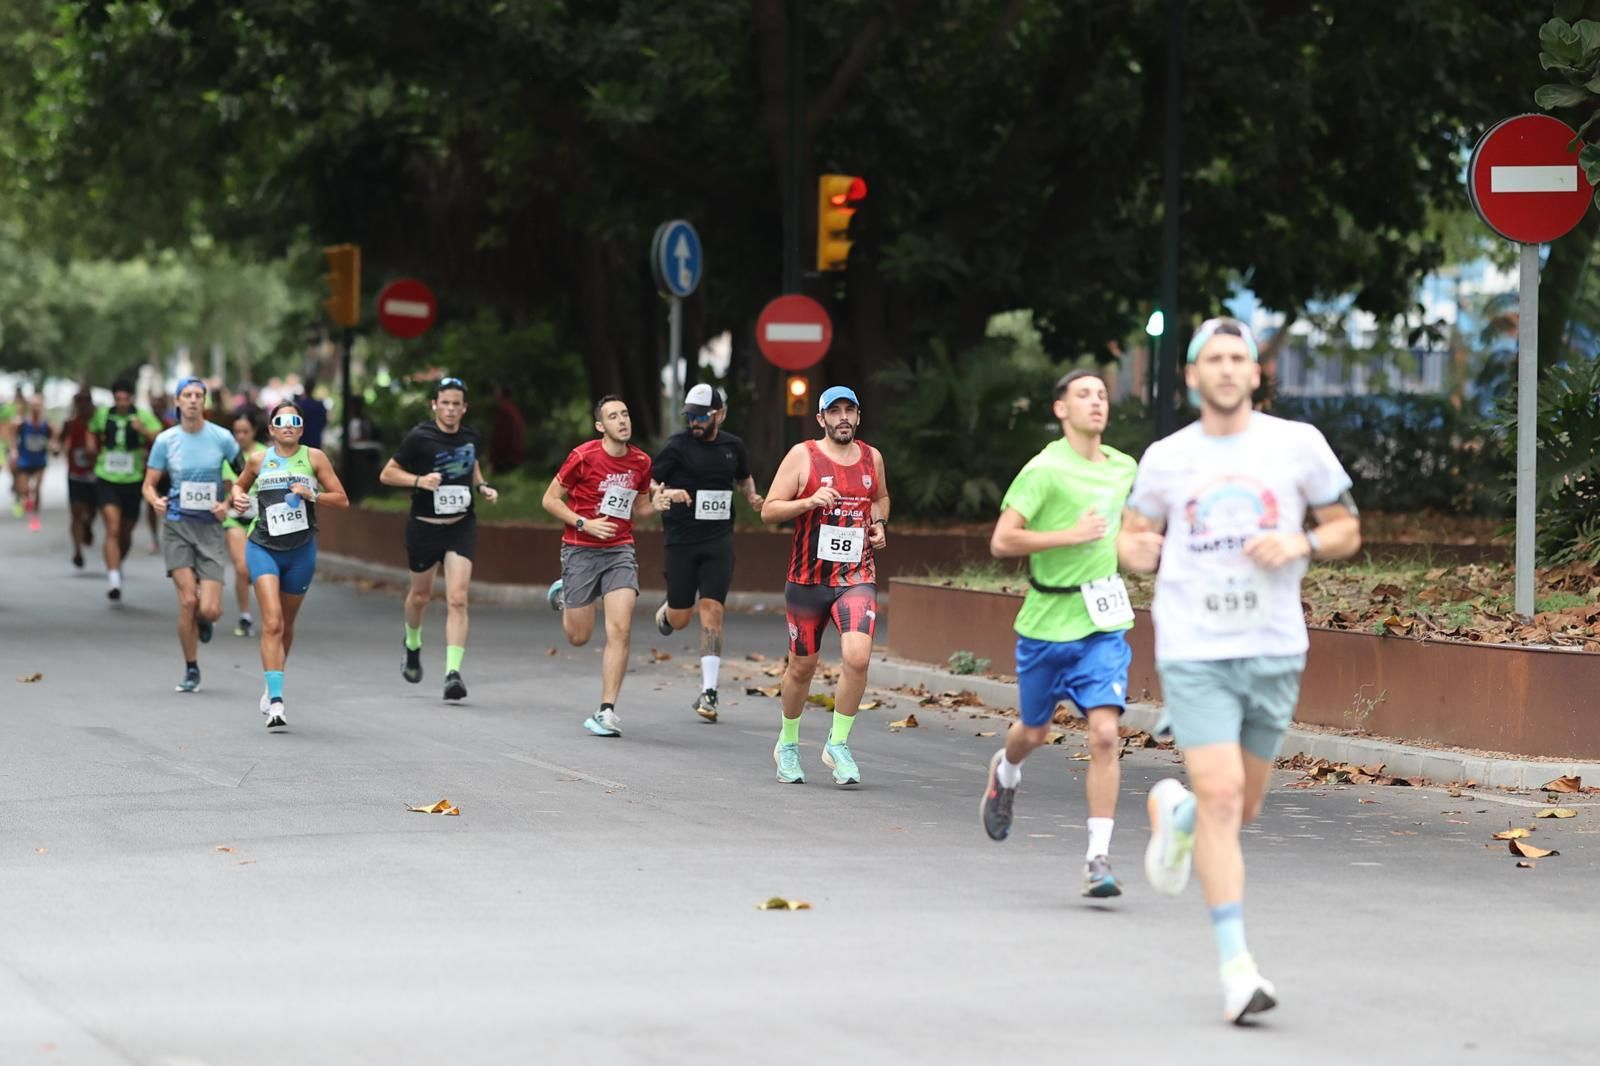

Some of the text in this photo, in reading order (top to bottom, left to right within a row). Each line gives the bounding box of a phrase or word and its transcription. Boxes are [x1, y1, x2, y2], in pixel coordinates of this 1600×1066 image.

[259, 475, 310, 486] TORREMONOS
[185, 491, 212, 501] 504
[439, 495, 464, 505] 931
[607, 495, 630, 509] 274
[702, 501, 727, 511] 604
[271, 510, 303, 524] 1126
[841, 509, 864, 517] CASA
[830, 538, 852, 552] 58
